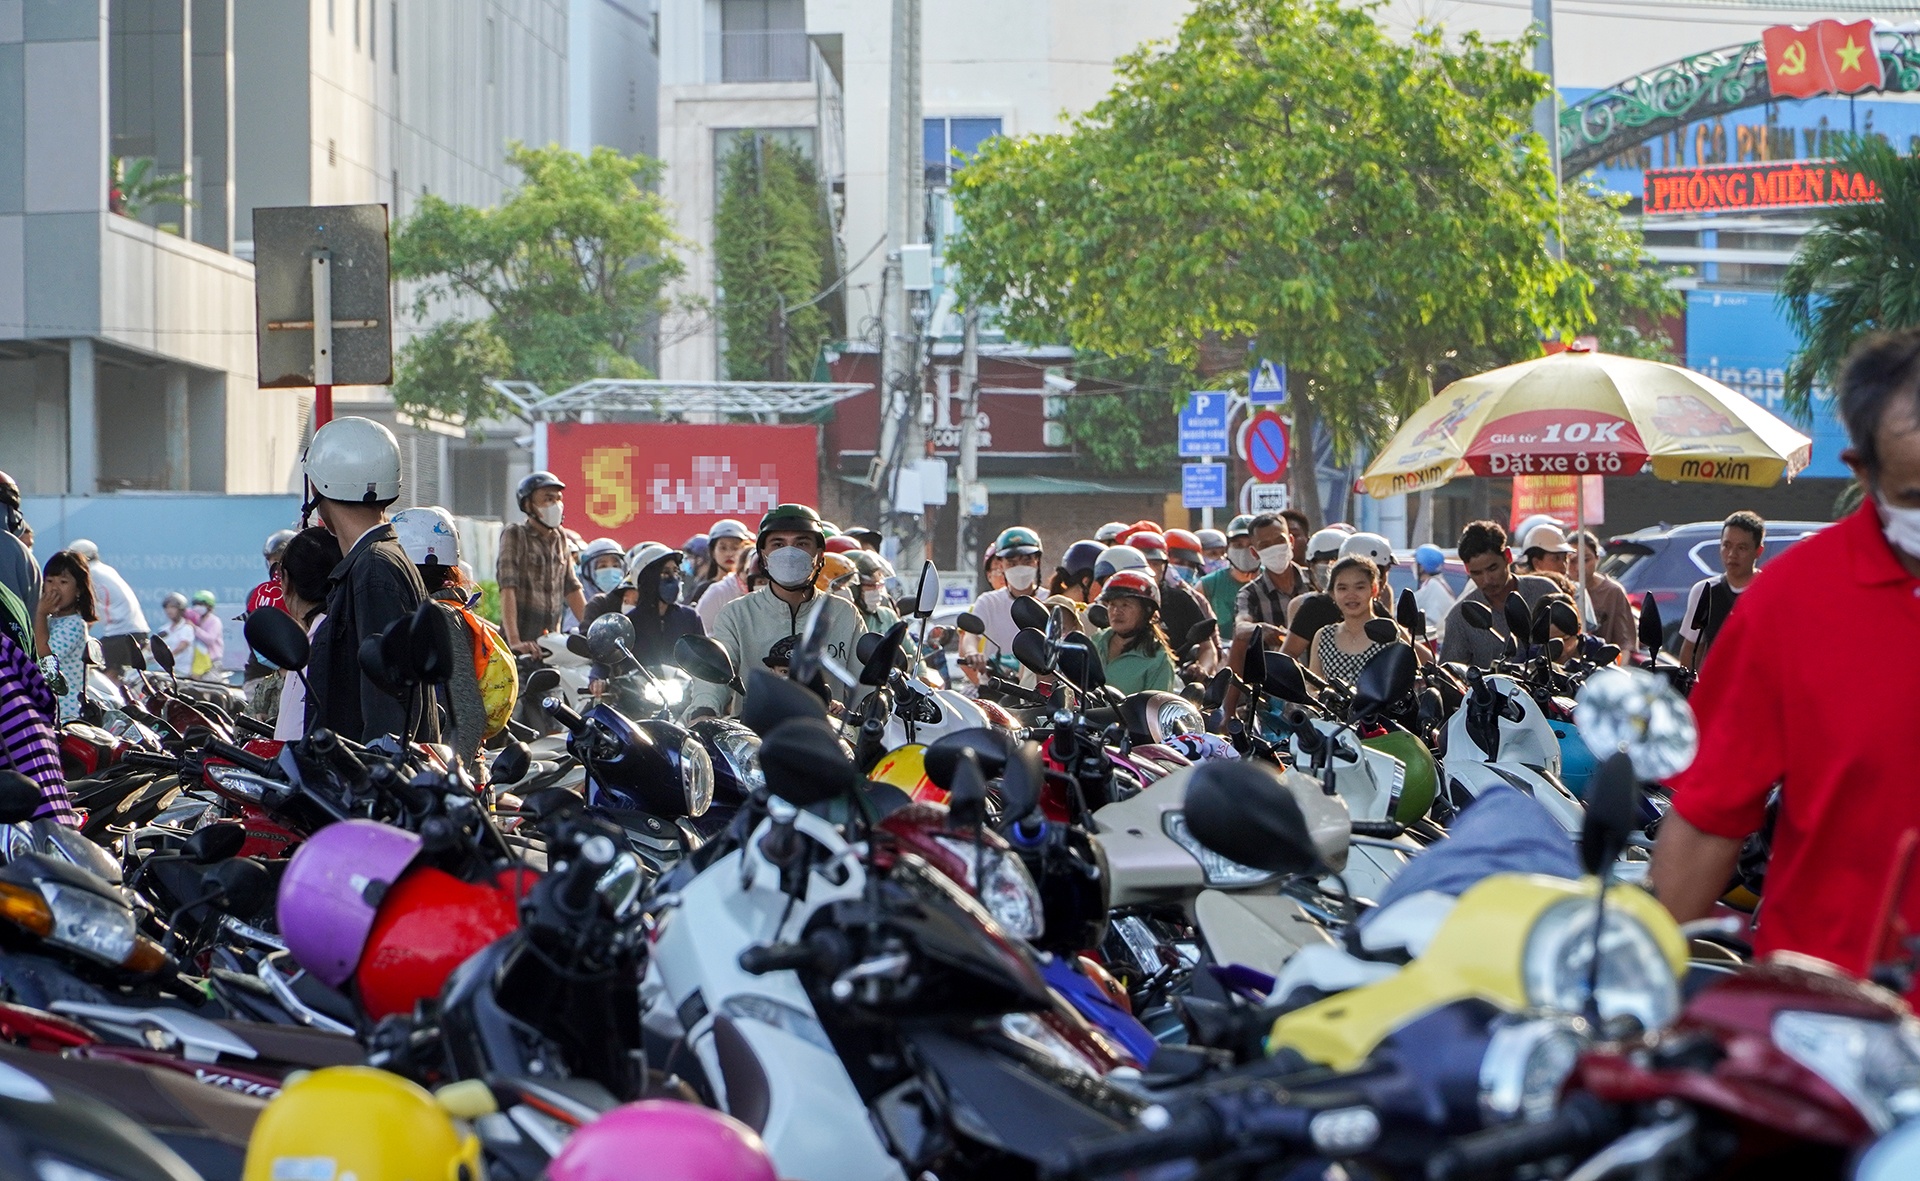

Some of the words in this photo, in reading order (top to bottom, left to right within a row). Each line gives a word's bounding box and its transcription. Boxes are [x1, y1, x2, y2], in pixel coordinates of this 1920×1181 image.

[1196, 395, 1210, 415] P
[1490, 433, 1515, 444] Giá
[1541, 421, 1625, 443] 10K
[1489, 451, 1534, 476] Đặt
[1540, 456, 1568, 472] xe
[1574, 451, 1590, 472] ô
[1596, 451, 1622, 472] tô
[1680, 457, 1750, 480] maxim
[1392, 463, 1443, 492] maxim
[143, 554, 184, 569] NEW
[245, 831, 288, 842] HONDA
[196, 1069, 284, 1100] VISIO
